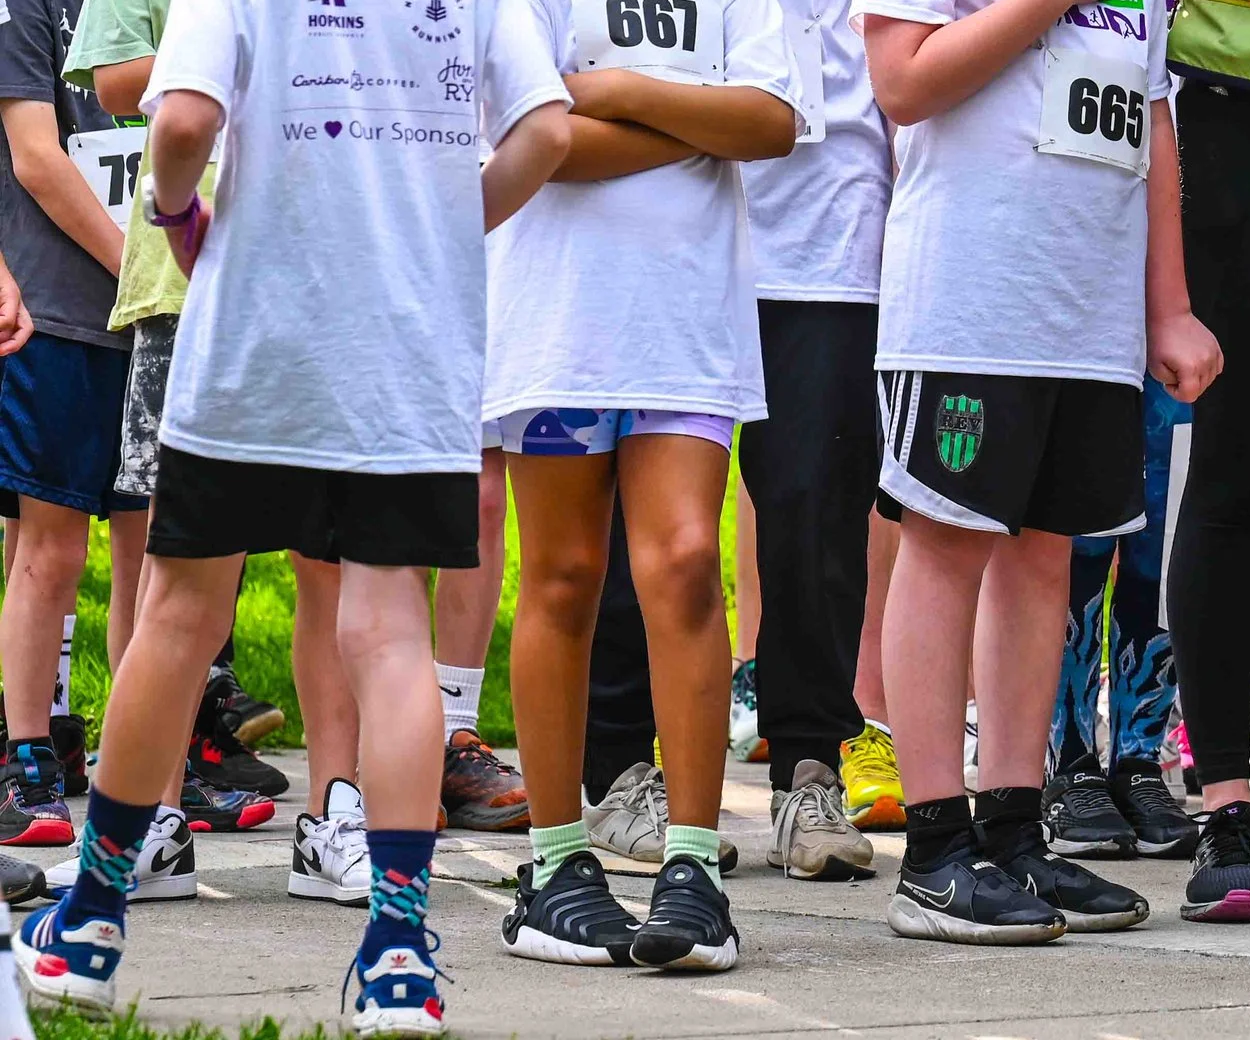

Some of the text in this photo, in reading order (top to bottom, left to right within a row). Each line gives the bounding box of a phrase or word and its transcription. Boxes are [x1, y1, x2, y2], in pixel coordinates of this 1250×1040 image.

[308, 14, 364, 29] HOPKINS
[411, 25, 461, 43] RUNNING
[1066, 77, 1145, 150] 665
[282, 123, 317, 141] We
[349, 120, 384, 141] Our
